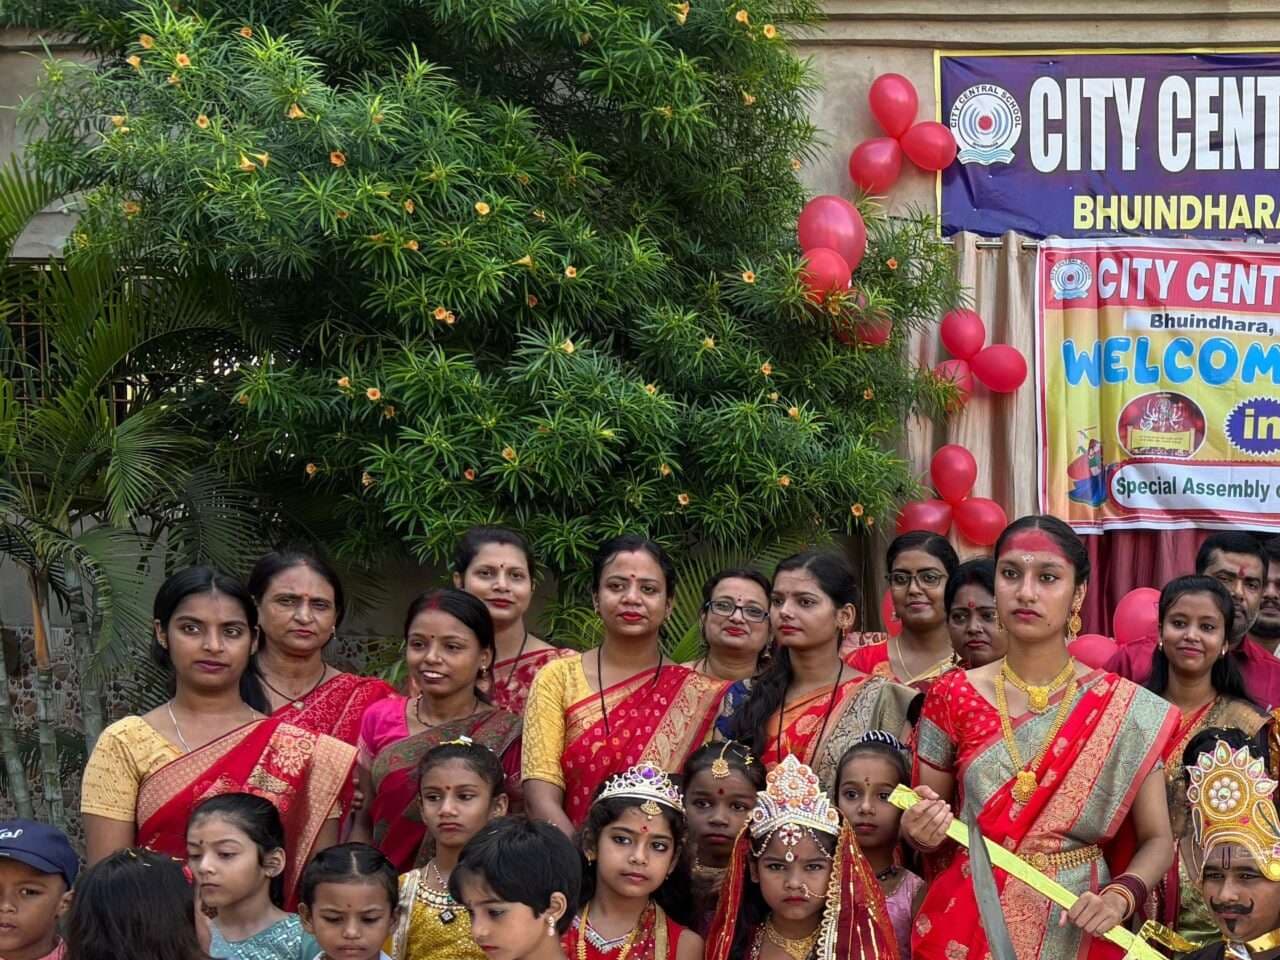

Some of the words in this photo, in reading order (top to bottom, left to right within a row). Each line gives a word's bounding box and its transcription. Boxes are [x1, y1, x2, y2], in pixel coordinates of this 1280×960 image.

[950, 105, 960, 128] CITY
[959, 85, 999, 104] CENTRAL
[1000, 91, 1022, 128] SCHOOL
[1029, 76, 1146, 173] CITY
[1098, 257, 1179, 300] CITY
[1150, 313, 1274, 336] Bhuindhara,
[1116, 476, 1177, 498] Special
[1182, 477, 1270, 503] Assembly
